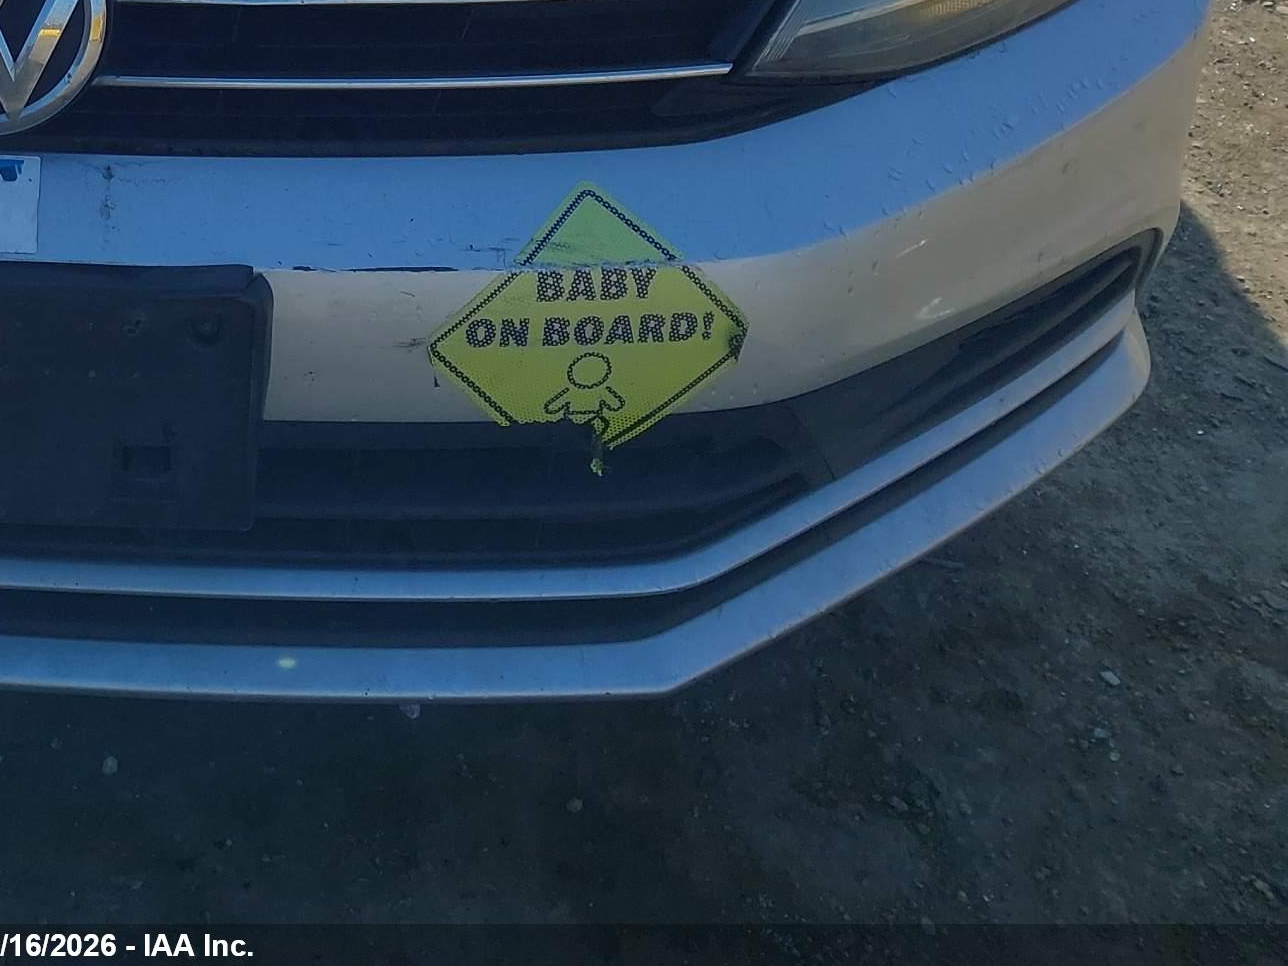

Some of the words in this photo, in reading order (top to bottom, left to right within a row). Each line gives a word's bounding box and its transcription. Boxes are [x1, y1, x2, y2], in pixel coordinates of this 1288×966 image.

[536, 266, 656, 303] BABY
[465, 317, 530, 348] ON
[542, 311, 714, 347] BOARD!
